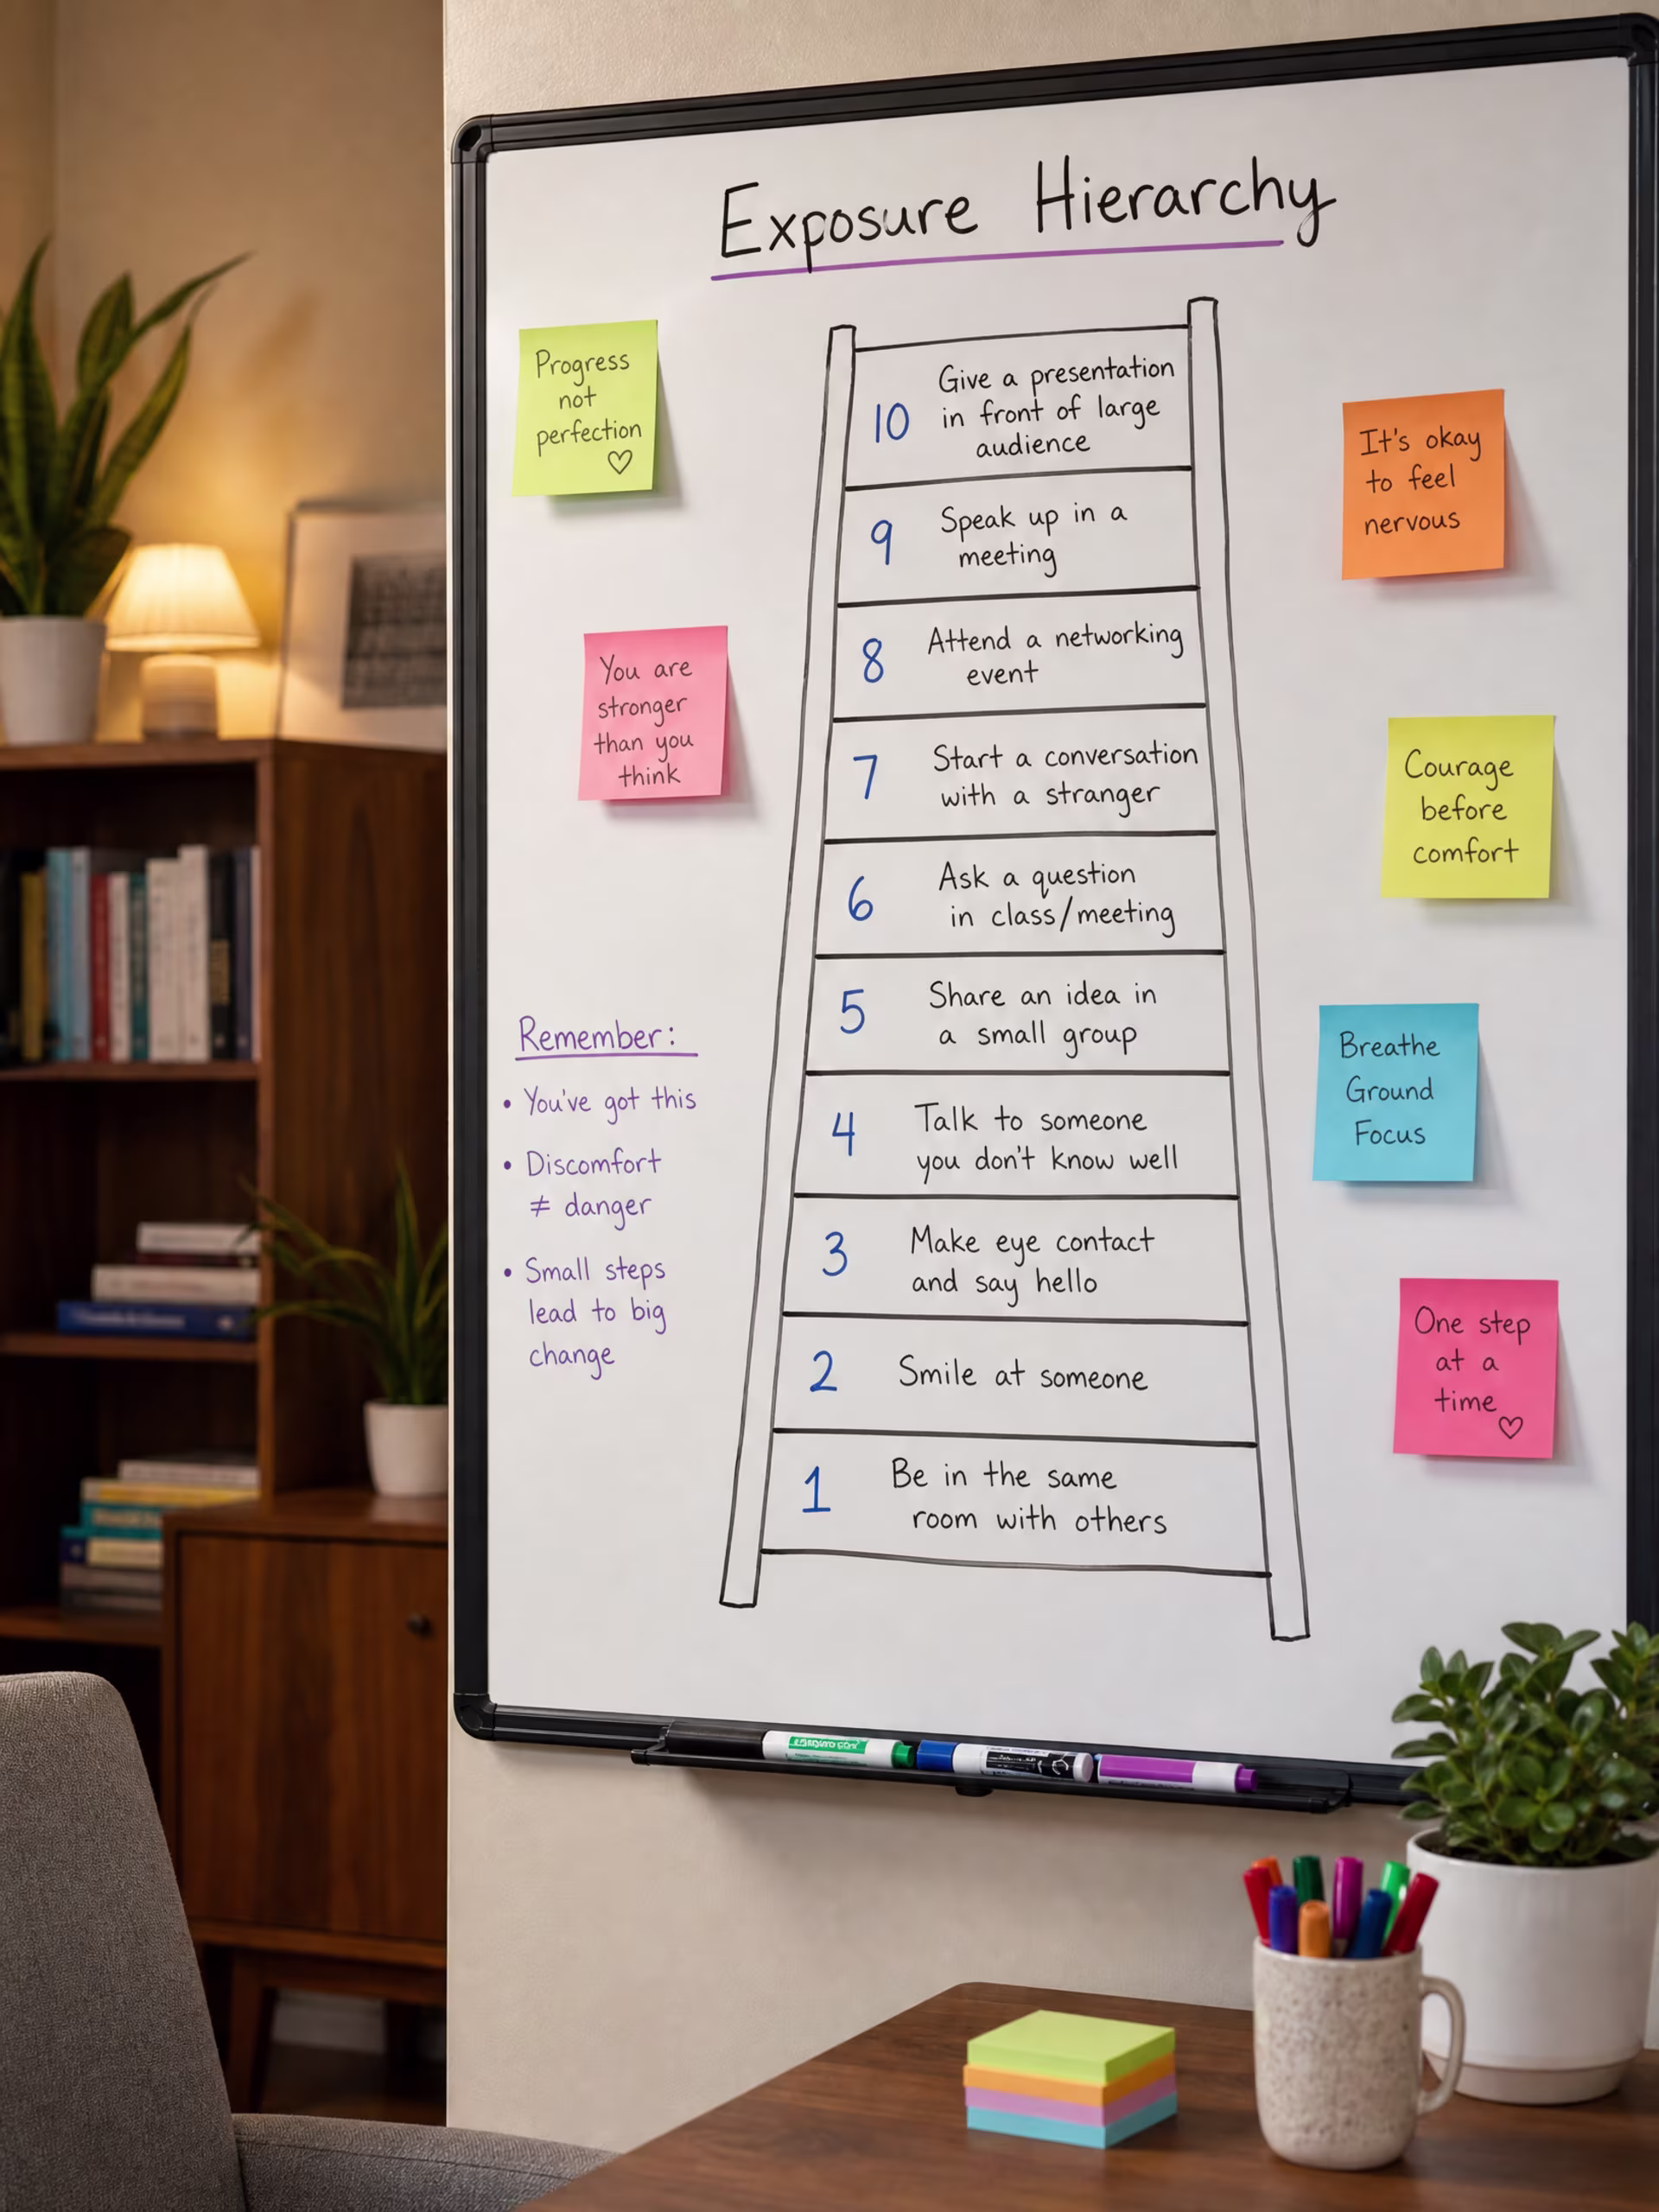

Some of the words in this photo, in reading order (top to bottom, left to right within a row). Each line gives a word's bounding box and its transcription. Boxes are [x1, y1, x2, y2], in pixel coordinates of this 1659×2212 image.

[721, 182, 979, 273] Exposure
[1037, 155, 1338, 247] Hierarchy
[535, 348, 630, 387] Progress
[938, 364, 992, 393] Give
[1002, 372, 1019, 387] a
[1030, 354, 1175, 397] presentation
[559, 385, 597, 410] not
[943, 407, 965, 429] in
[979, 397, 1045, 426] front
[1056, 392, 1082, 421] of
[1097, 394, 1160, 430] large
[536, 417, 642, 458] perfection
[875, 402, 910, 444] 10
[976, 431, 1091, 459] audience
[1359, 427, 1410, 456] It's
[1426, 424, 1482, 462] okay
[1365, 468, 1393, 494] to
[1408, 462, 1456, 491] feel
[941, 504, 1016, 543] Speak
[1028, 509, 1059, 537] up
[1074, 501, 1096, 523] in
[1110, 505, 1128, 521] a
[1364, 508, 1461, 536] nervous
[870, 519, 893, 566] 9
[958, 540, 1058, 579] meeting
[927, 625, 1012, 655] Attend
[1026, 634, 1042, 649] a
[1055, 620, 1185, 659] networking
[599, 653, 641, 685] You
[654, 658, 693, 678] are
[862, 637, 884, 683] 8
[966, 658, 1039, 686] event
[598, 695, 688, 728] stronger
[593, 731, 644, 755] than
[655, 730, 695, 763] you
[933, 743, 1003, 772] Start
[1015, 753, 1033, 768] a
[1045, 739, 1198, 767] conversation
[618, 761, 682, 788] think
[853, 753, 878, 800] 7
[1404, 748, 1515, 792] Courage
[941, 782, 996, 808] with
[1013, 790, 1031, 805] a
[1046, 780, 1161, 819] stranger
[1421, 793, 1508, 822] before
[1413, 836, 1520, 865] comfort
[848, 875, 874, 922] 6
[938, 861, 990, 892] Ask
[1002, 872, 1020, 887] a
[1032, 860, 1136, 899] question
[951, 905, 974, 928] in
[991, 895, 1176, 939] class/meeting
[840, 988, 866, 1035] 5
[929, 980, 1006, 1009] Share
[1020, 989, 1052, 1006] an
[1066, 979, 1121, 1006] idea
[1135, 982, 1157, 1004] in
[518, 1014, 675, 1052] Remember:
[938, 1029, 957, 1046] a
[977, 1019, 1046, 1046] small
[1063, 1026, 1137, 1059] group
[1339, 1030, 1440, 1059] Breathe
[523, 1085, 592, 1116] You've
[604, 1086, 640, 1126] got
[651, 1085, 696, 1110] this
[1345, 1075, 1434, 1103] Ground
[831, 1111, 855, 1157] 4
[913, 1102, 979, 1133] Talk
[994, 1104, 1023, 1132] to
[1040, 1113, 1147, 1132] someone
[1355, 1118, 1427, 1147] Focus
[526, 1147, 662, 1177] Discomfort
[916, 1155, 961, 1185] you
[975, 1145, 1036, 1171] don't
[1051, 1145, 1115, 1171] know
[1129, 1143, 1178, 1170] well
[564, 1191, 652, 1231] danger
[822, 1230, 848, 1277] 3
[911, 1224, 981, 1255] Make
[995, 1234, 1041, 1268] eye
[1056, 1225, 1155, 1253] contact
[525, 1255, 590, 1284] Small
[605, 1255, 666, 1291] steps
[912, 1267, 958, 1293] and
[975, 1274, 1019, 1308] say
[1035, 1267, 1098, 1294] hello
[529, 1297, 577, 1325] lead
[591, 1297, 616, 1323] to
[630, 1296, 667, 1335] big
[1414, 1305, 1465, 1335] One
[1478, 1309, 1531, 1346] step
[529, 1340, 615, 1381] change
[809, 1350, 838, 1393] 2
[899, 1353, 977, 1387] Smile
[995, 1357, 1026, 1387] at
[1040, 1369, 1148, 1391] someone
[1435, 1347, 1465, 1372] at
[1482, 1357, 1500, 1371] a
[1433, 1387, 1497, 1413] time
[802, 1465, 831, 1514] 1
[892, 1457, 929, 1489] Be
[944, 1463, 968, 1487] in
[982, 1459, 1031, 1488] the
[1047, 1469, 1117, 1490] same
[912, 1510, 978, 1529] room
[996, 1503, 1057, 1531] with
[1075, 1504, 1167, 1535] others
